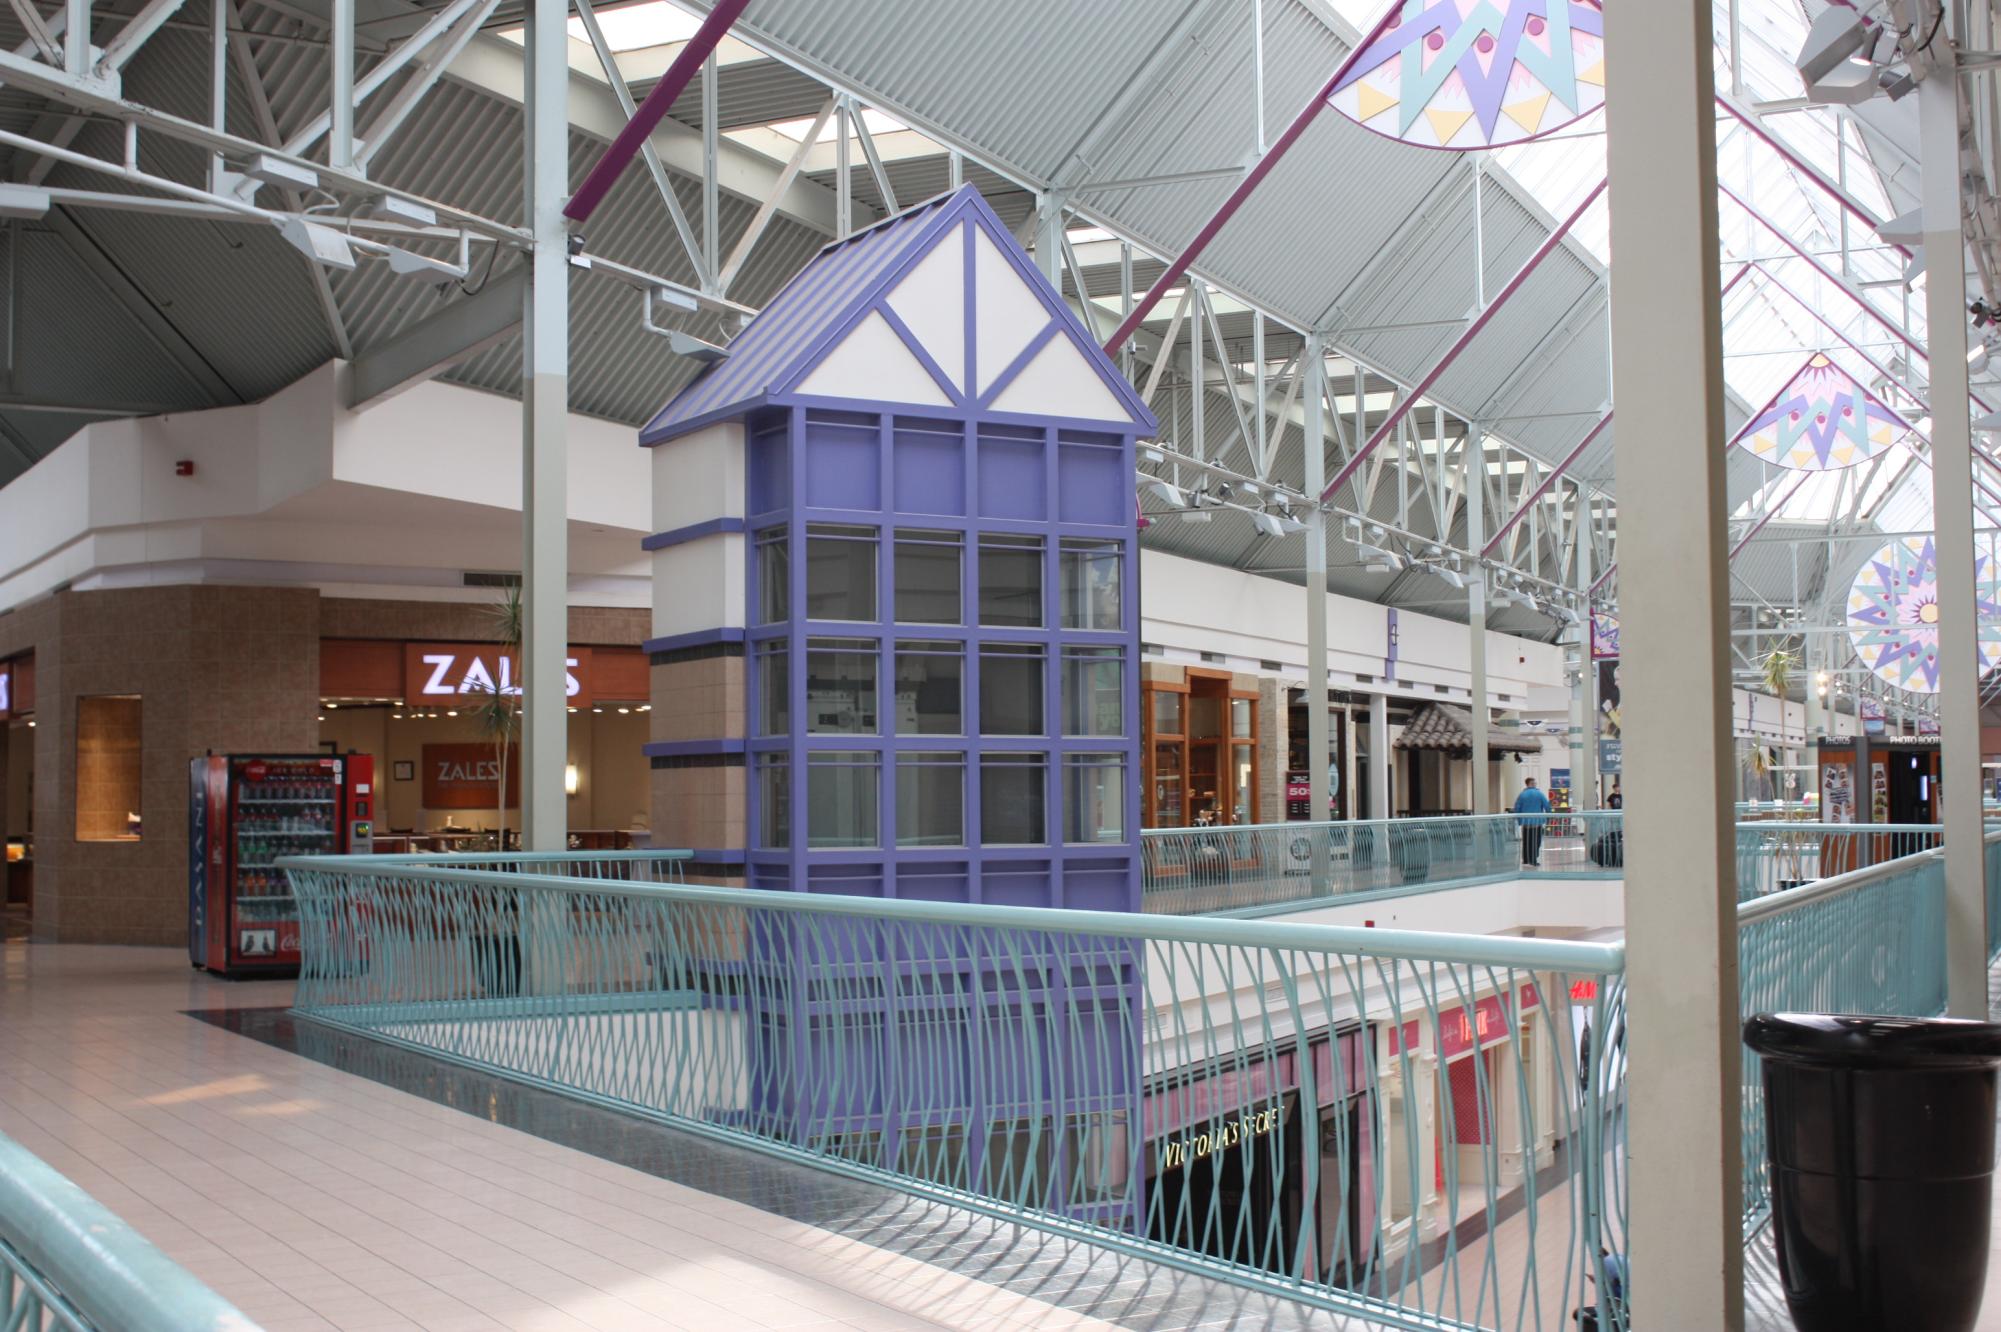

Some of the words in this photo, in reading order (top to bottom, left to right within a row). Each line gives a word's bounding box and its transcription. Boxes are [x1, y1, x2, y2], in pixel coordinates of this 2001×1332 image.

[422, 655, 580, 697] ZALS
[1826, 736, 1851, 744] PHOTOS
[1890, 736, 1916, 744] PHOTO
[1918, 736, 1941, 744] BOOT
[438, 761, 499, 781] ZALES
[1243, 1105, 1285, 1138] SCRE
